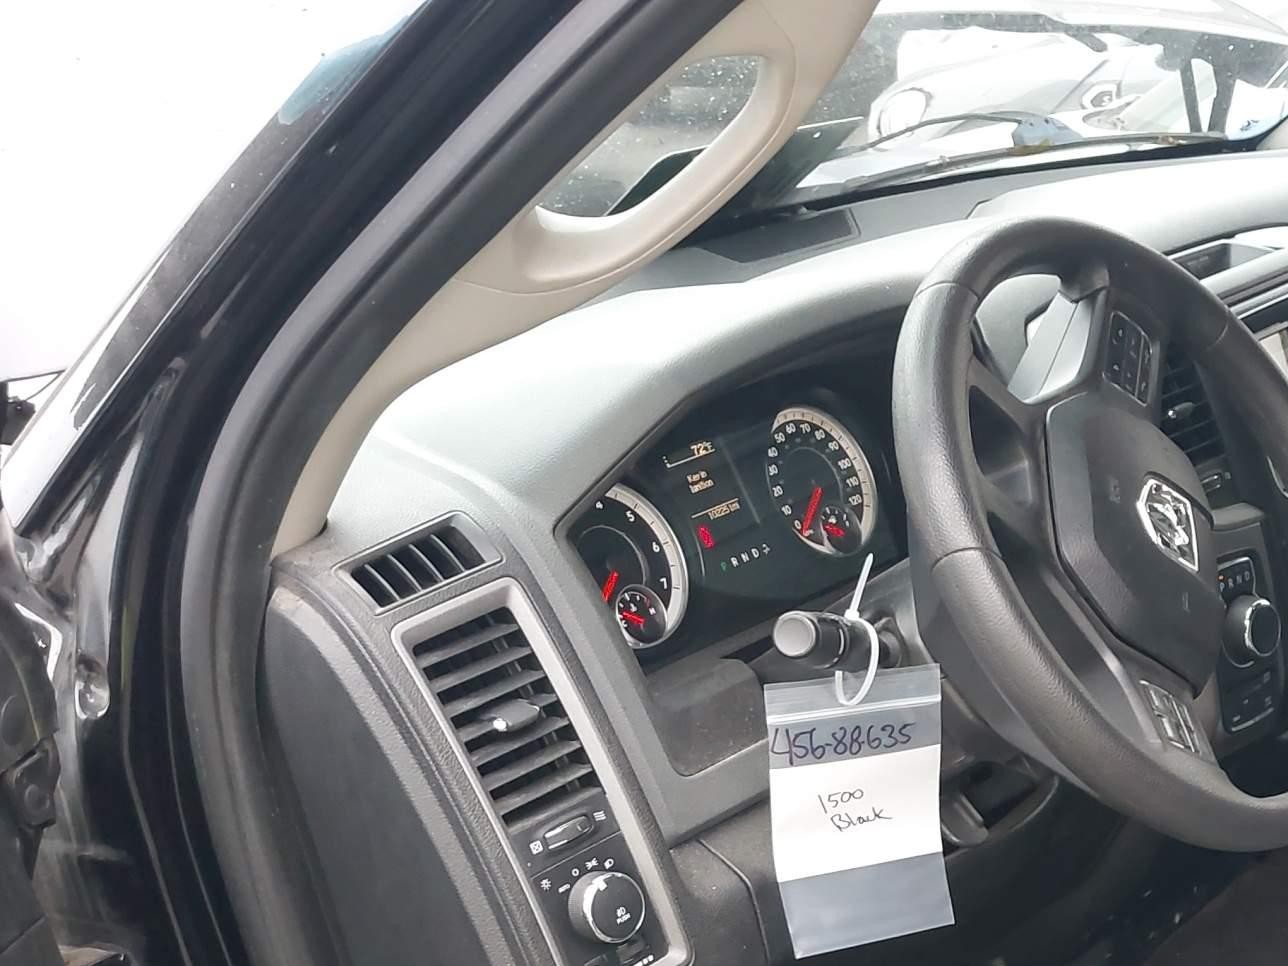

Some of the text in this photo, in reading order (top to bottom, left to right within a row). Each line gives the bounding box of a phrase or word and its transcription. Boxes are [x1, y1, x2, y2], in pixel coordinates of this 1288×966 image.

[785, 423, 797, 434] 60
[800, 423, 812, 434] 70
[814, 429, 826, 440] 80
[774, 432, 786, 443] 50
[828, 440, 839, 451] 90
[767, 447, 778, 457] 40
[768, 464, 778, 476] 30
[838, 458, 851, 470] 100
[846, 476, 859, 487] 110
[772, 485, 783, 497] 20
[595, 501, 603, 510] 4
[848, 494, 862, 506] 120
[625, 510, 635, 522] 5
[781, 504, 792, 516] 10
[794, 519, 802, 529] 0
[652, 541, 660, 553] 6
[659, 577, 668, 590] 7
[817, 788, 865, 814] 1500
[830, 806, 893, 832] Black
